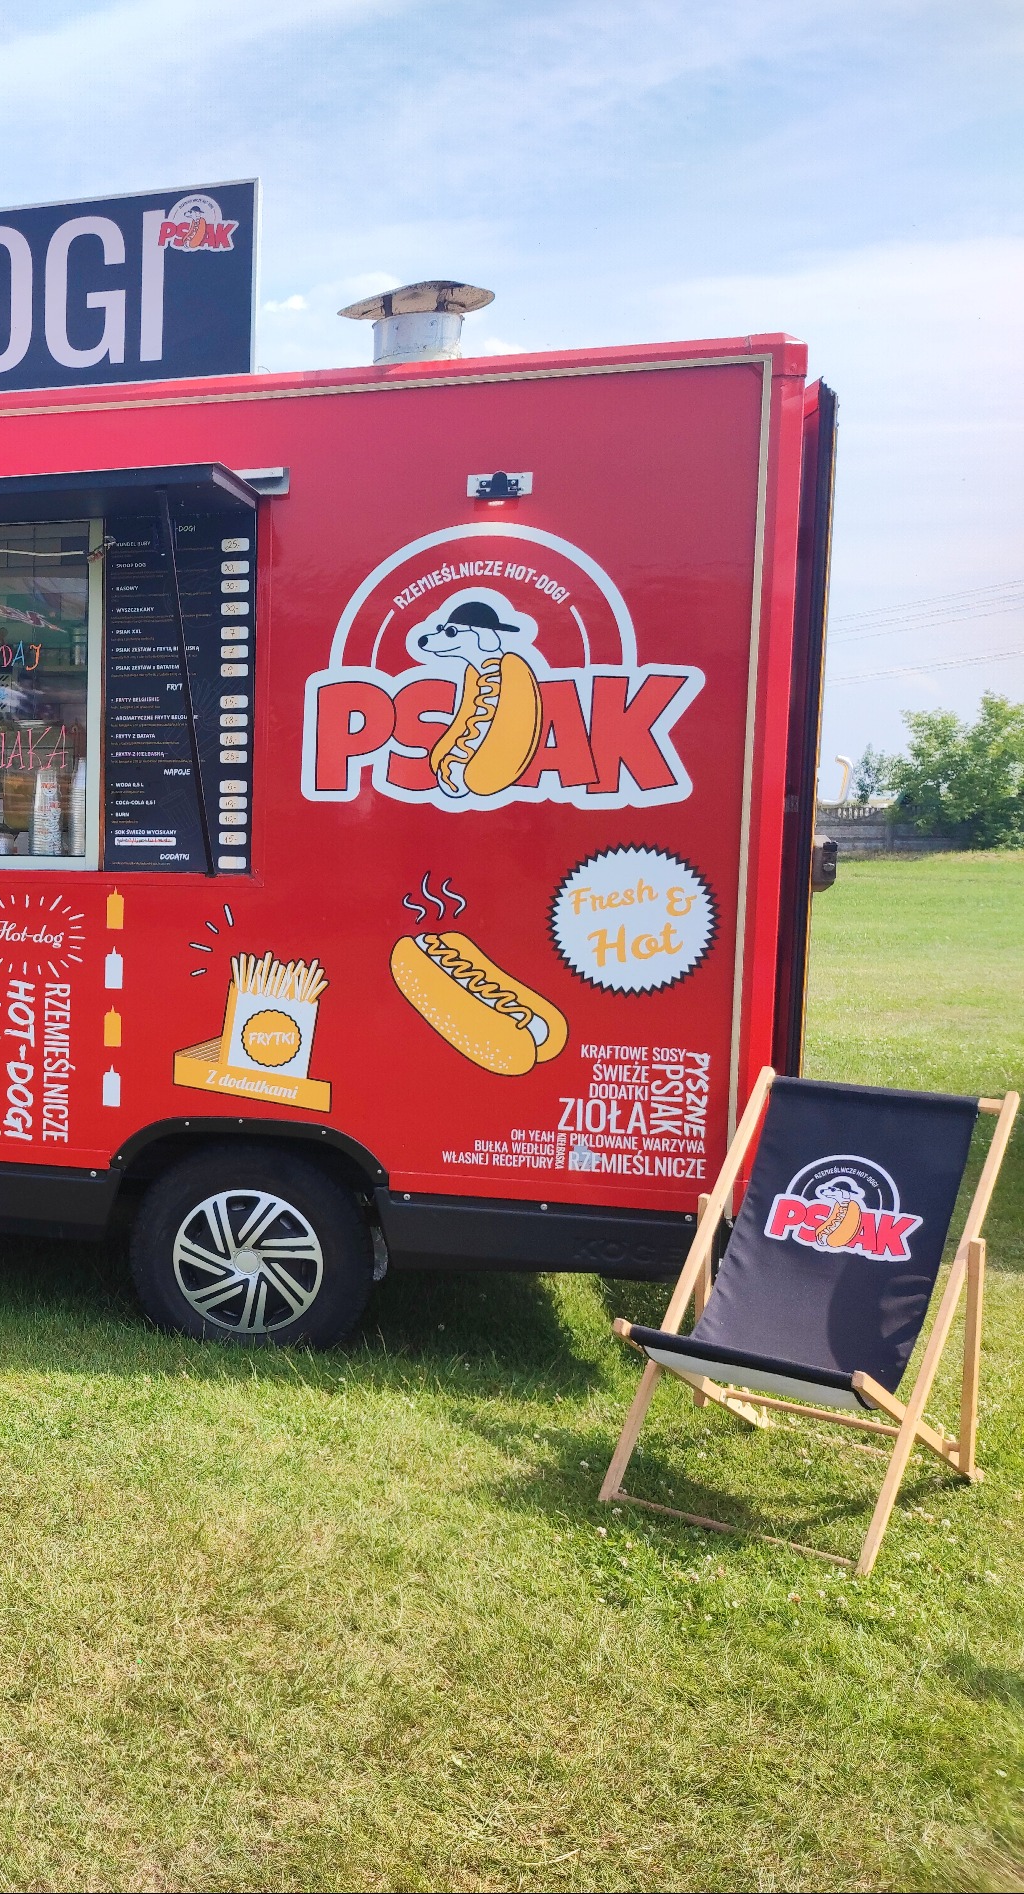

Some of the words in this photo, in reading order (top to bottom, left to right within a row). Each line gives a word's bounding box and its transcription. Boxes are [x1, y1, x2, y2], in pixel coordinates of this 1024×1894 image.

[393, 560, 502, 610] RZEMIEŚLNICZE
[504, 561, 571, 605] HOT-DOGI
[163, 768, 191, 776] NAPOJE
[159, 853, 190, 861] DODATKI
[568, 878, 659, 916] Fresh
[665, 886, 697, 917] &
[587, 922, 684, 968] Hot
[247, 1031, 296, 1046] FRYTKI
[580, 1043, 649, 1062] KRAFTOWE
[652, 1046, 687, 1062] SOSY
[3, 979, 36, 1141] HOT-DOGI
[42, 982, 75, 1144] RZEMIEŚLNICZE
[592, 1058, 650, 1084] ŚWIEŻE
[205, 1069, 218, 1085] Z
[218, 1073, 299, 1101] dodatkami
[588, 1082, 649, 1101] DODATKI
[683, 1050, 711, 1140] PYSZNE
[649, 1063, 684, 1137] PSIAK
[557, 1096, 648, 1136] ZIOŁA
[474, 1139, 508, 1153] BUŁKA
[511, 1141, 555, 1156] WEDŁUG
[510, 1128, 526, 1142] OH
[527, 1129, 555, 1143] YEAH
[569, 1132, 639, 1151] PIKLOWANE
[642, 1137, 706, 1154] WARZYWA
[441, 1150, 490, 1166] WŁASNEJ
[492, 1153, 554, 1170] RECEPTURY
[567, 1150, 707, 1180] RZEMIEŚLNICZE
